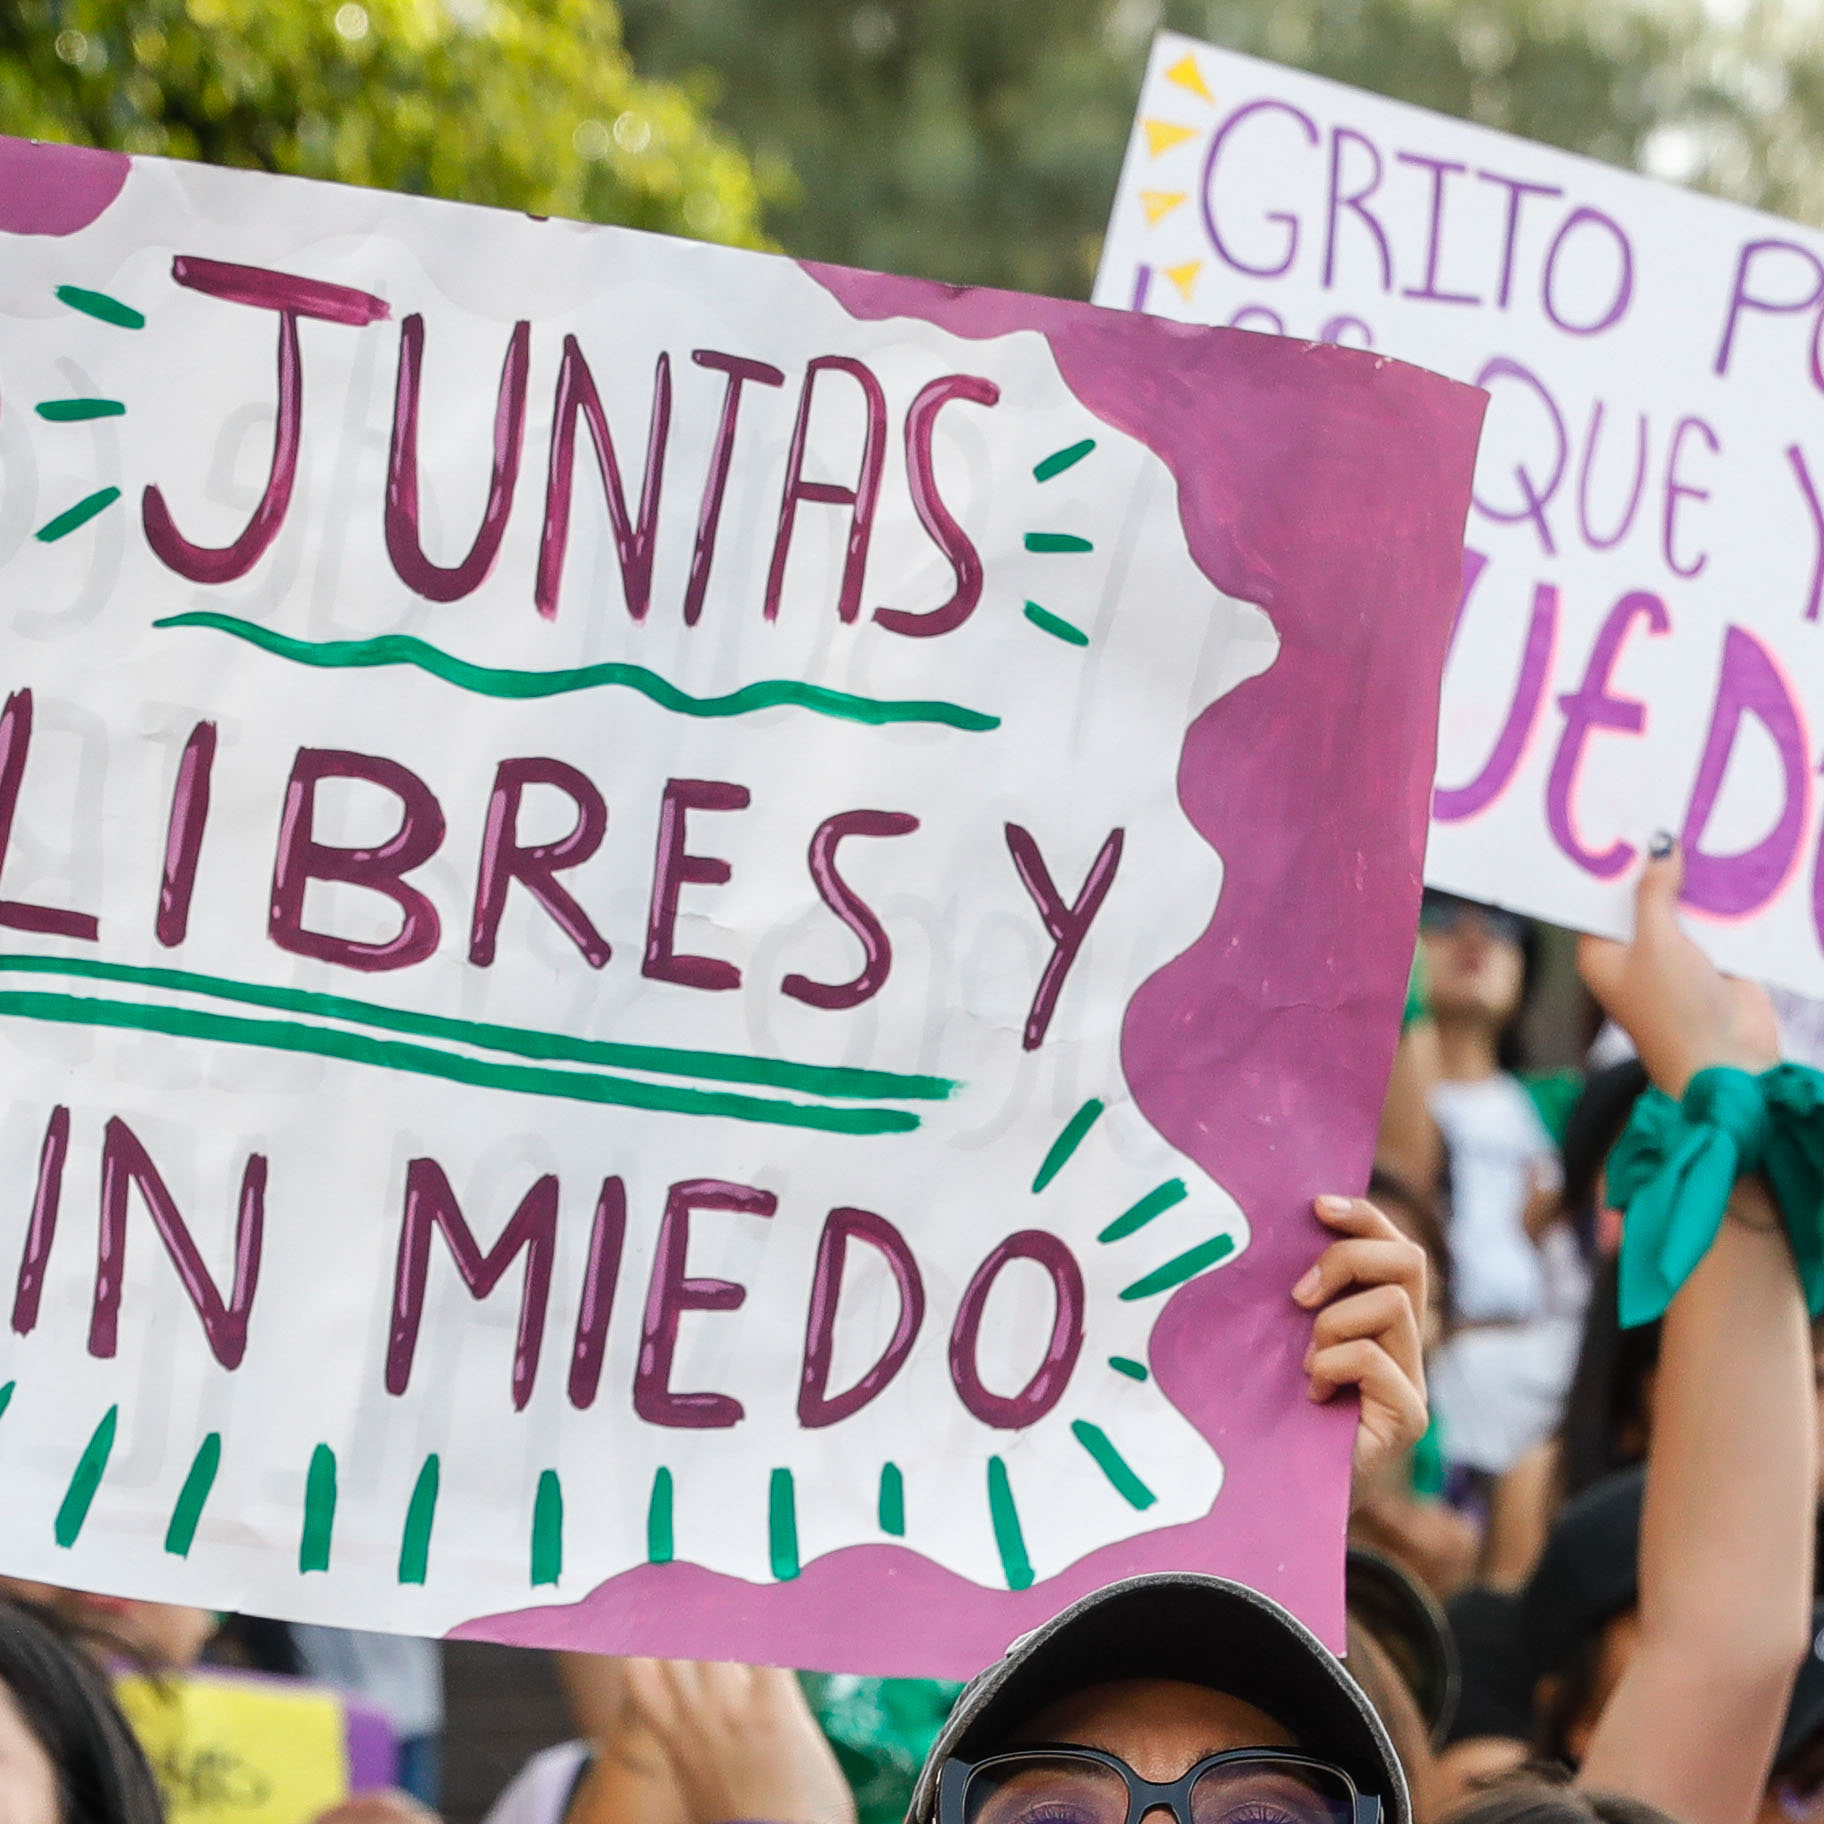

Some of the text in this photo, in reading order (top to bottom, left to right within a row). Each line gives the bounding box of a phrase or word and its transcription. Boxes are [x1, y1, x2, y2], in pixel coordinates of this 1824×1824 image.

[1200, 99, 1634, 336] GRITO
[142, 255, 1000, 638] JUNTAS
[1471, 356, 1721, 577] QUE
[1005, 822, 1126, 1050] Y
[388, 1157, 1085, 1430] MIEDO
